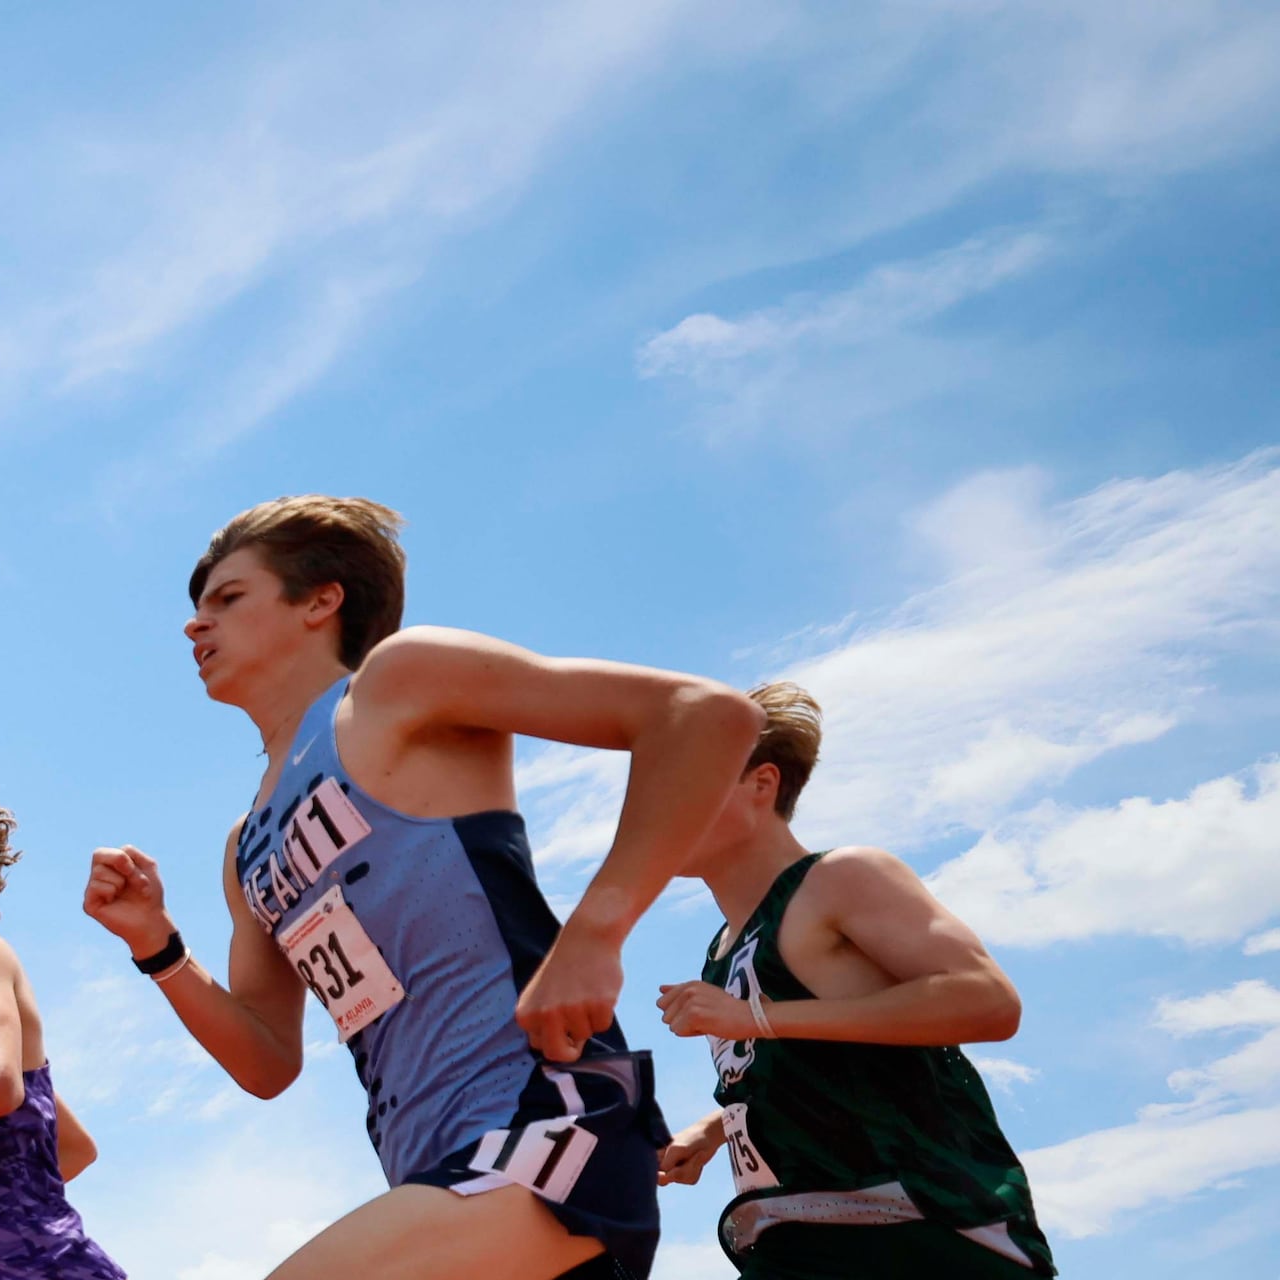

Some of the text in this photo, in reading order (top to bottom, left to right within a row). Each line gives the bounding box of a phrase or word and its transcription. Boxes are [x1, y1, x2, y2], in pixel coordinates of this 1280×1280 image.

[290, 793, 348, 872] 11
[297, 930, 366, 1010] 831
[345, 997, 375, 1022] ATLANTA
[727, 1129, 760, 1177] 75
